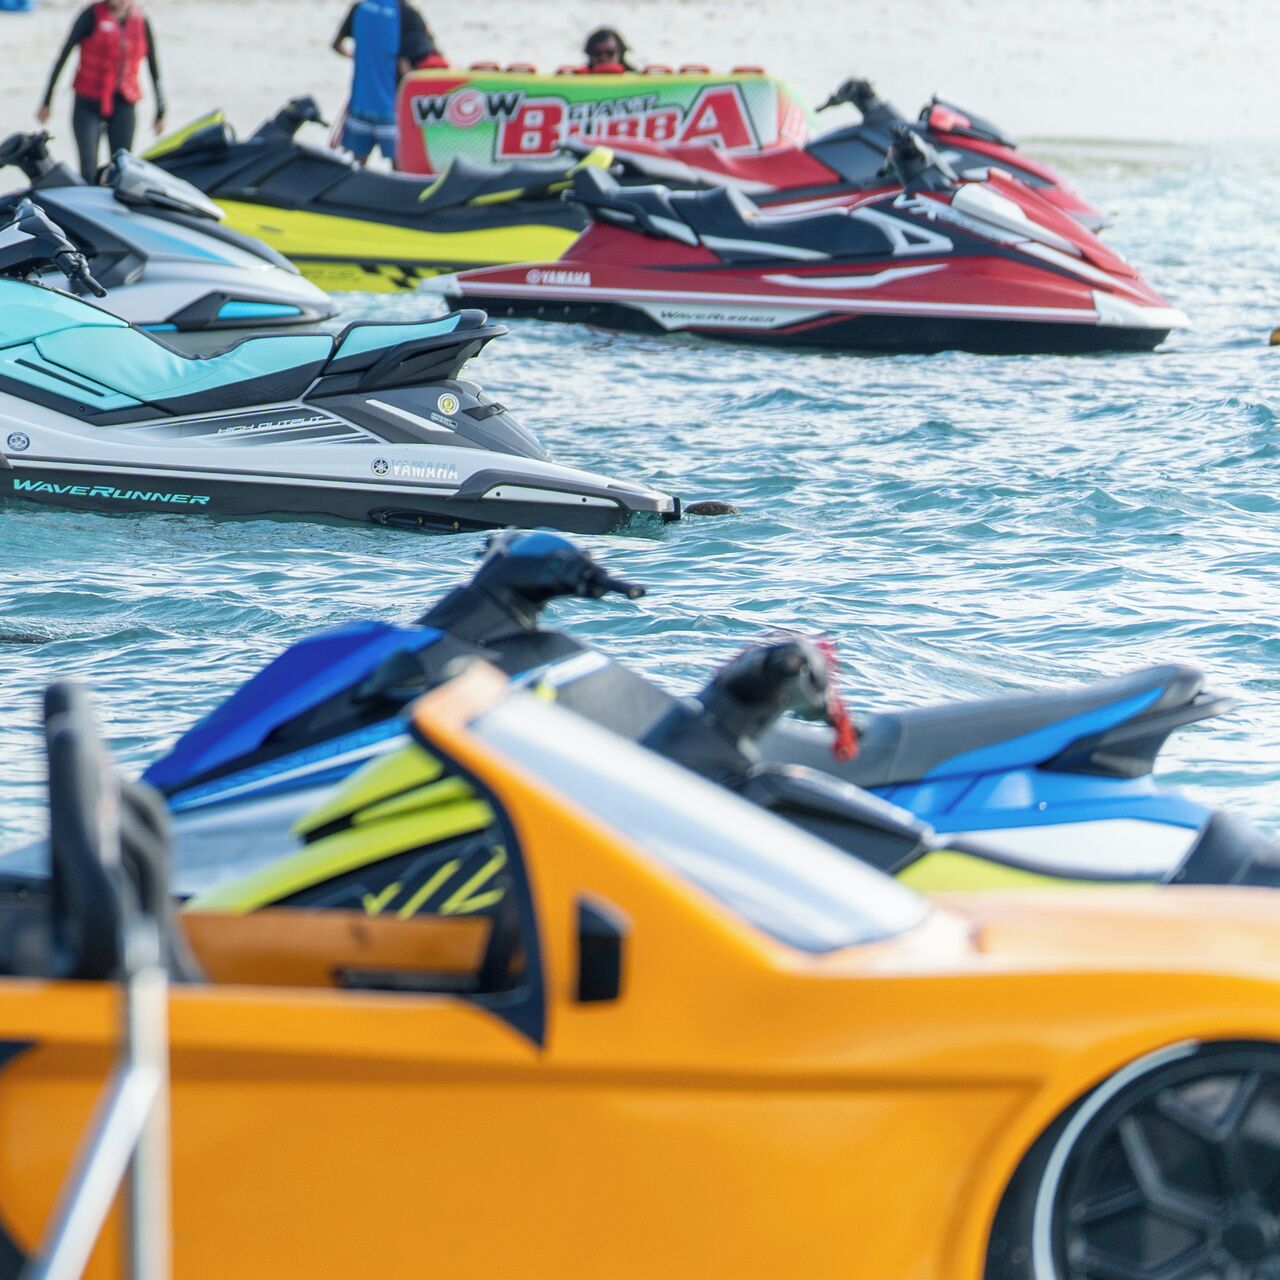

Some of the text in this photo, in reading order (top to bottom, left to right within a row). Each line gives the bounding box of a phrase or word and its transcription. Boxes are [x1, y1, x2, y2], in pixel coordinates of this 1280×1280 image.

[411, 88, 526, 128] WOW
[542, 270, 592, 287] YAMAHA
[217, 415, 324, 435] HIGH OUTPUT
[391, 460, 459, 480] YAMAHA
[13, 479, 211, 505] WAVERUNNER
